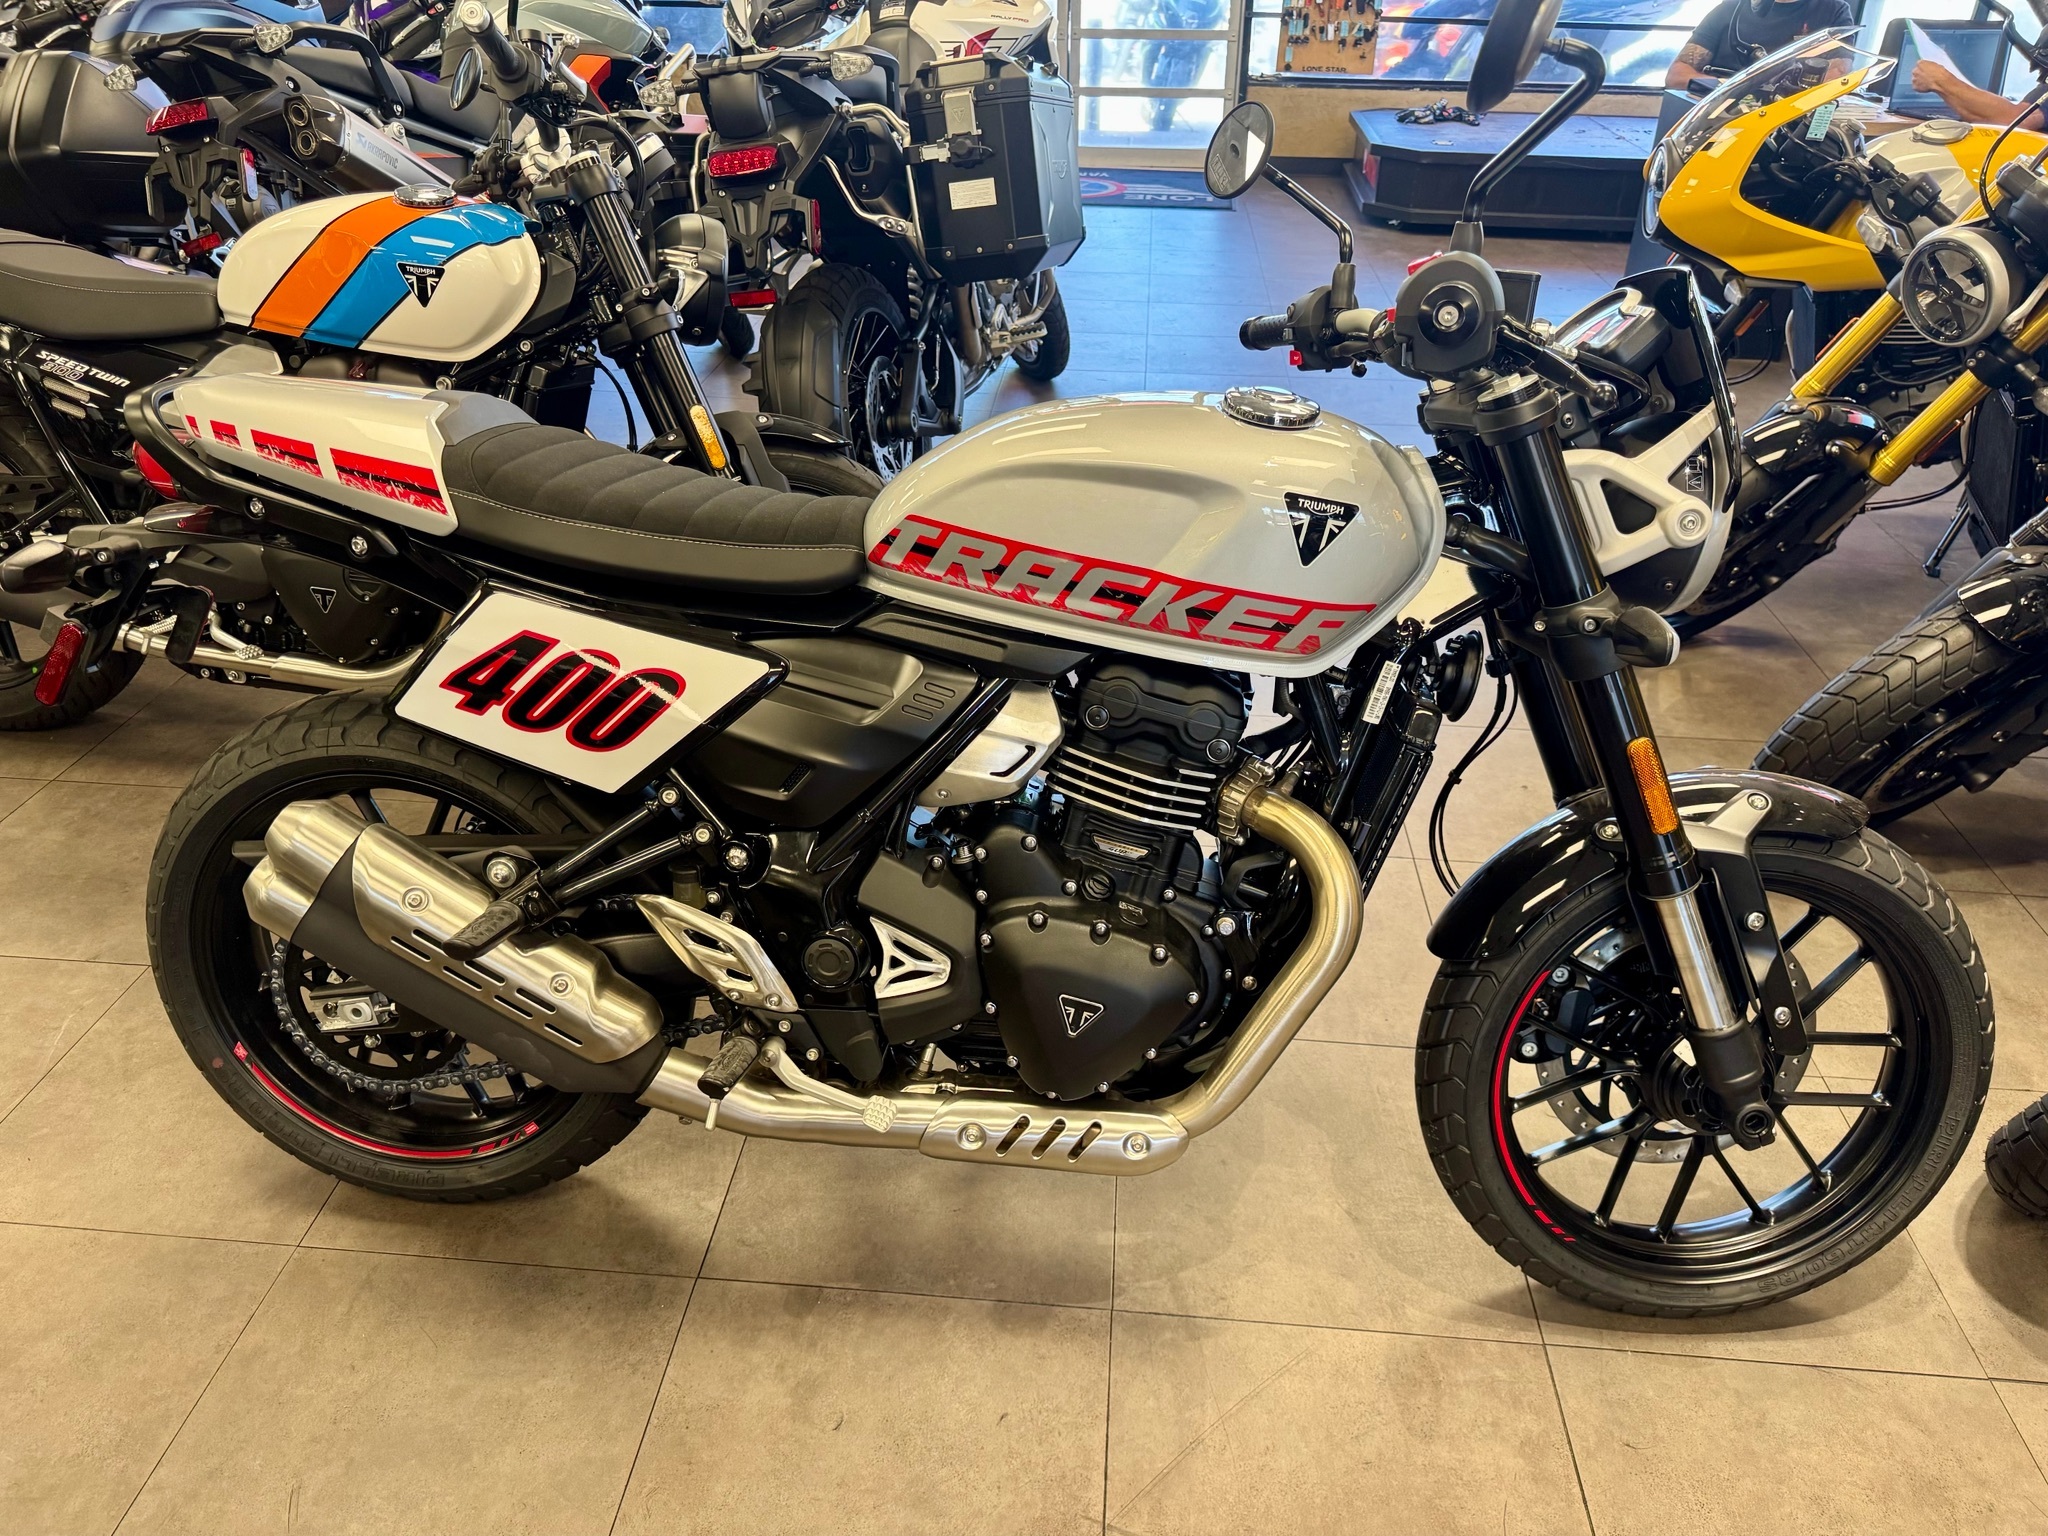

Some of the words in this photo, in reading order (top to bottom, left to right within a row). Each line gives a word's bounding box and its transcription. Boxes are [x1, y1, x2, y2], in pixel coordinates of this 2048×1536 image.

[1123, 194, 1214, 202] LONE
[405, 265, 436, 276] TRIUMPH
[35, 350, 90, 373] SPEED
[88, 366, 131, 388] TWIN
[39, 361, 85, 381] 900
[1297, 498, 1345, 516] TRIUMPH
[881, 519, 1369, 650] TRACKER
[439, 629, 686, 752] 400
[330, 1152, 446, 1189] PIRELLI
[1883, 1114, 1960, 1223] PIRELLI
[1811, 1217, 1882, 1274] MT60
[1757, 1270, 1799, 1294] RS
